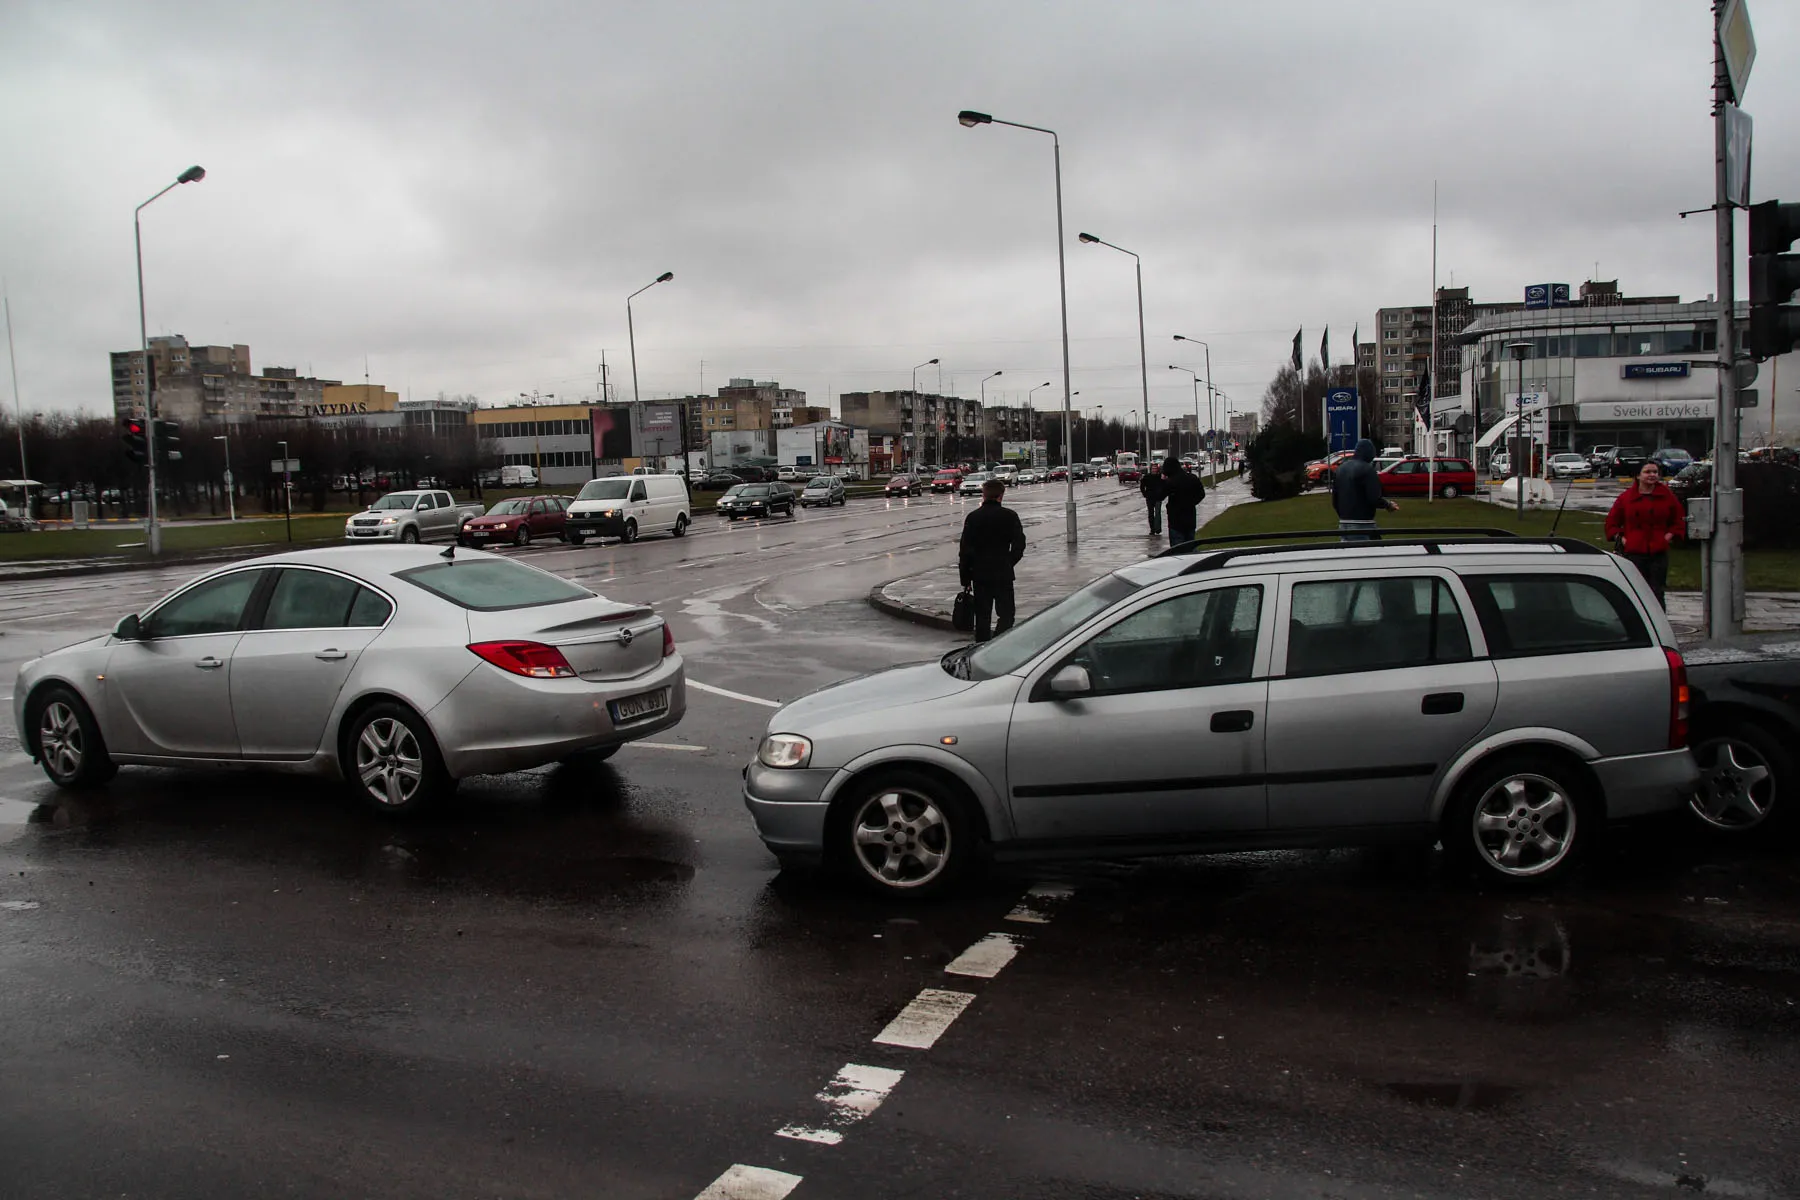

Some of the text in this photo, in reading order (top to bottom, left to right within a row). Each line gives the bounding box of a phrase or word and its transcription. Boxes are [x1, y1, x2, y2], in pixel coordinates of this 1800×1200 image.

[1645, 366, 1682, 374] SUBARU
[303, 402, 367, 417] TAVYDAS
[1613, 404, 1652, 417] Sveiki
[1656, 403, 1700, 419] atvykę
